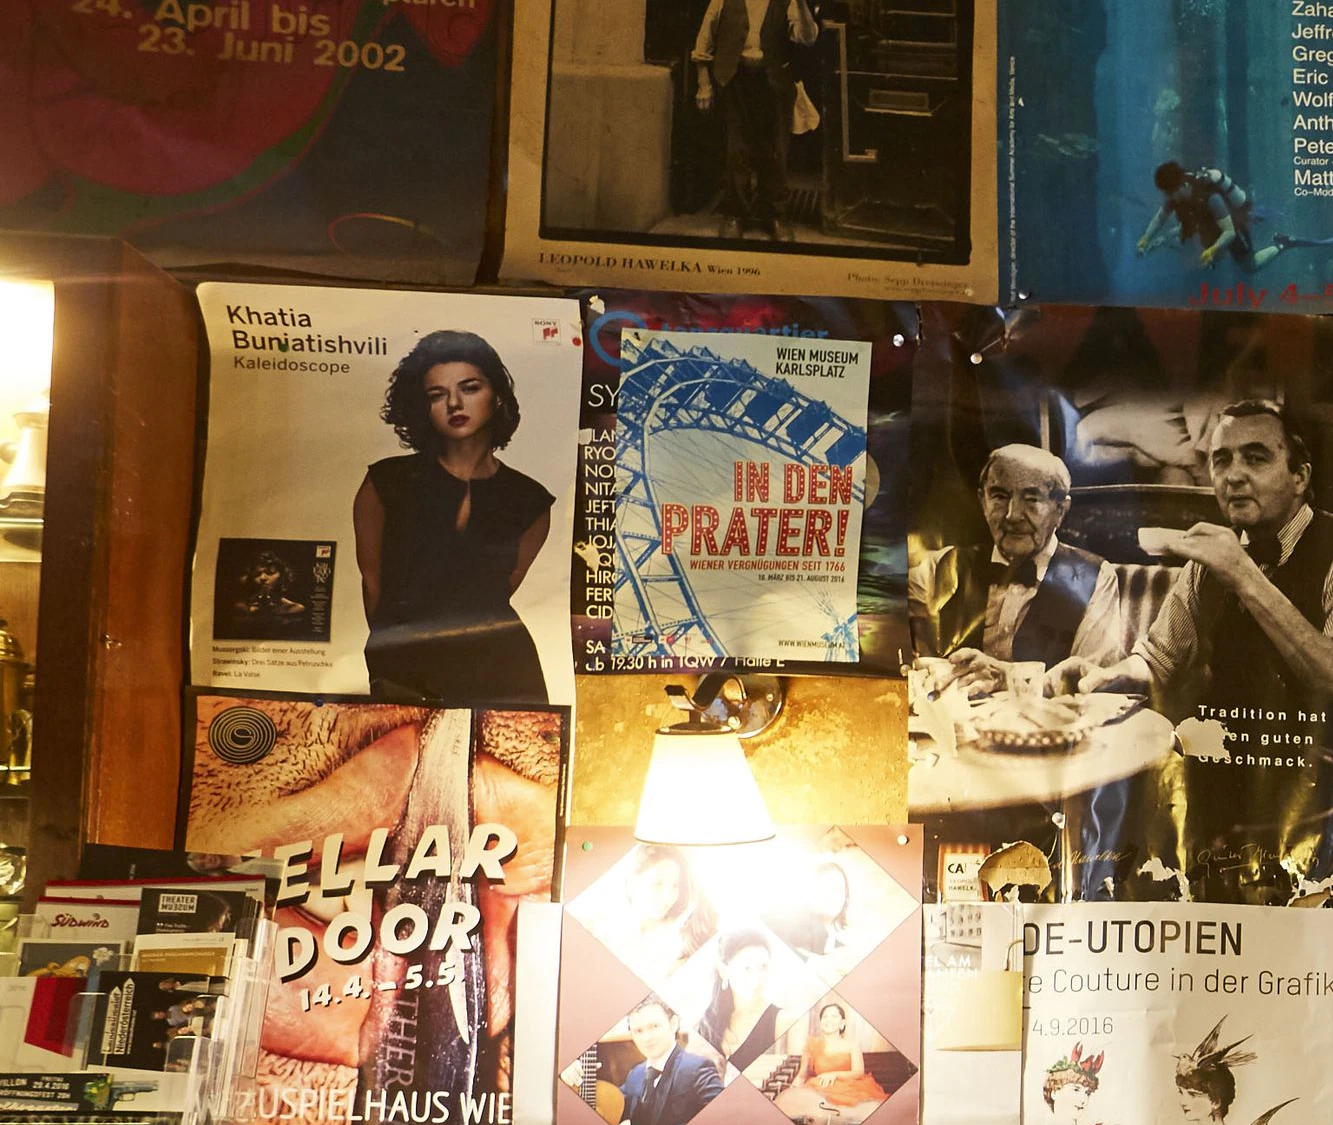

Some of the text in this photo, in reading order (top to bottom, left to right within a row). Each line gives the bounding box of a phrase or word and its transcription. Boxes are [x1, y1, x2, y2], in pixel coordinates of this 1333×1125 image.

[154, 0, 331, 36] April bis
[138, 24, 406, 72] 23. Juni 2002
[1293, 69, 1328, 85] Eric
[1293, 91, 1333, 107] Wolf
[539, 252, 761, 277] LEOPOLD HAWELKA Wien 1996
[1188, 282, 1268, 309] July
[227, 305, 312, 328] Khatia
[232, 330, 388, 356] Buniatishvili
[233, 357, 350, 375] Kaleidoscope
[777, 348, 859, 364] WIEN MUSEUM
[776, 362, 845, 378] KARLSPLATZ
[733, 461, 853, 505] IN DEN
[661, 503, 849, 557] PRATER!
[690, 559, 845, 572] WIENER VERGNÜGUNGEN SEIT 1766
[1199, 705, 1327, 722] Tradition hat
[1261, 733, 1313, 745] guten
[51, 913, 109, 929] SÜDWIND
[276, 901, 483, 983] DOOR
[299, 974, 369, 1011] 14.4.
[1052, 968, 1160, 994] Couture
[1170, 967, 1193, 992] in
[1204, 967, 1249, 995] der
[1032, 1016, 1114, 1036] 4.9.2016
